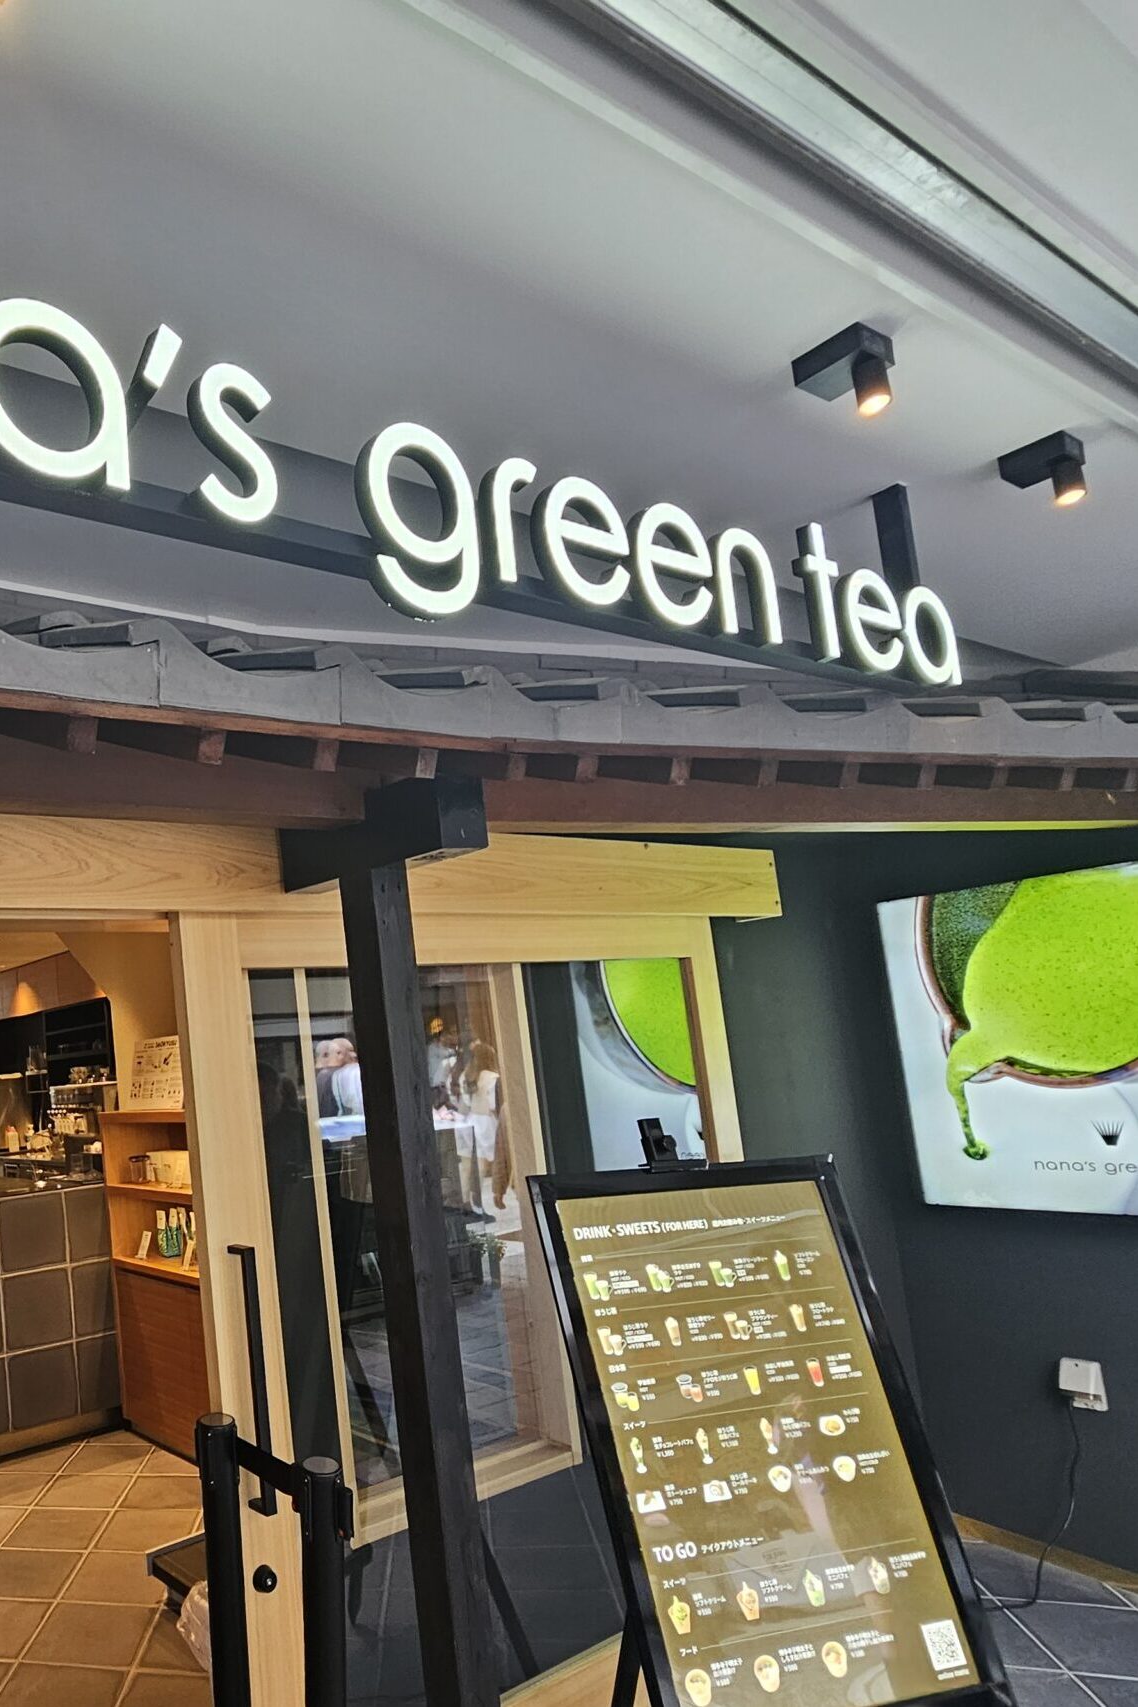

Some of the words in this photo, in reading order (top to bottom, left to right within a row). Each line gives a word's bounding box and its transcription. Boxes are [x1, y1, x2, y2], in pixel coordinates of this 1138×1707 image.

[360, 420, 785, 646] green
[792, 521, 963, 686] tea
[1033, 1159, 1097, 1172] nana's
[623, 1420, 645, 1430] スイーツ
[652, 1545, 673, 1562] TO
[675, 1541, 697, 1558] GO
[701, 1537, 763, 1553] テイクアウトメニュー
[662, 1577, 685, 1588] スイーツ
[679, 1645, 697, 1656] フード
